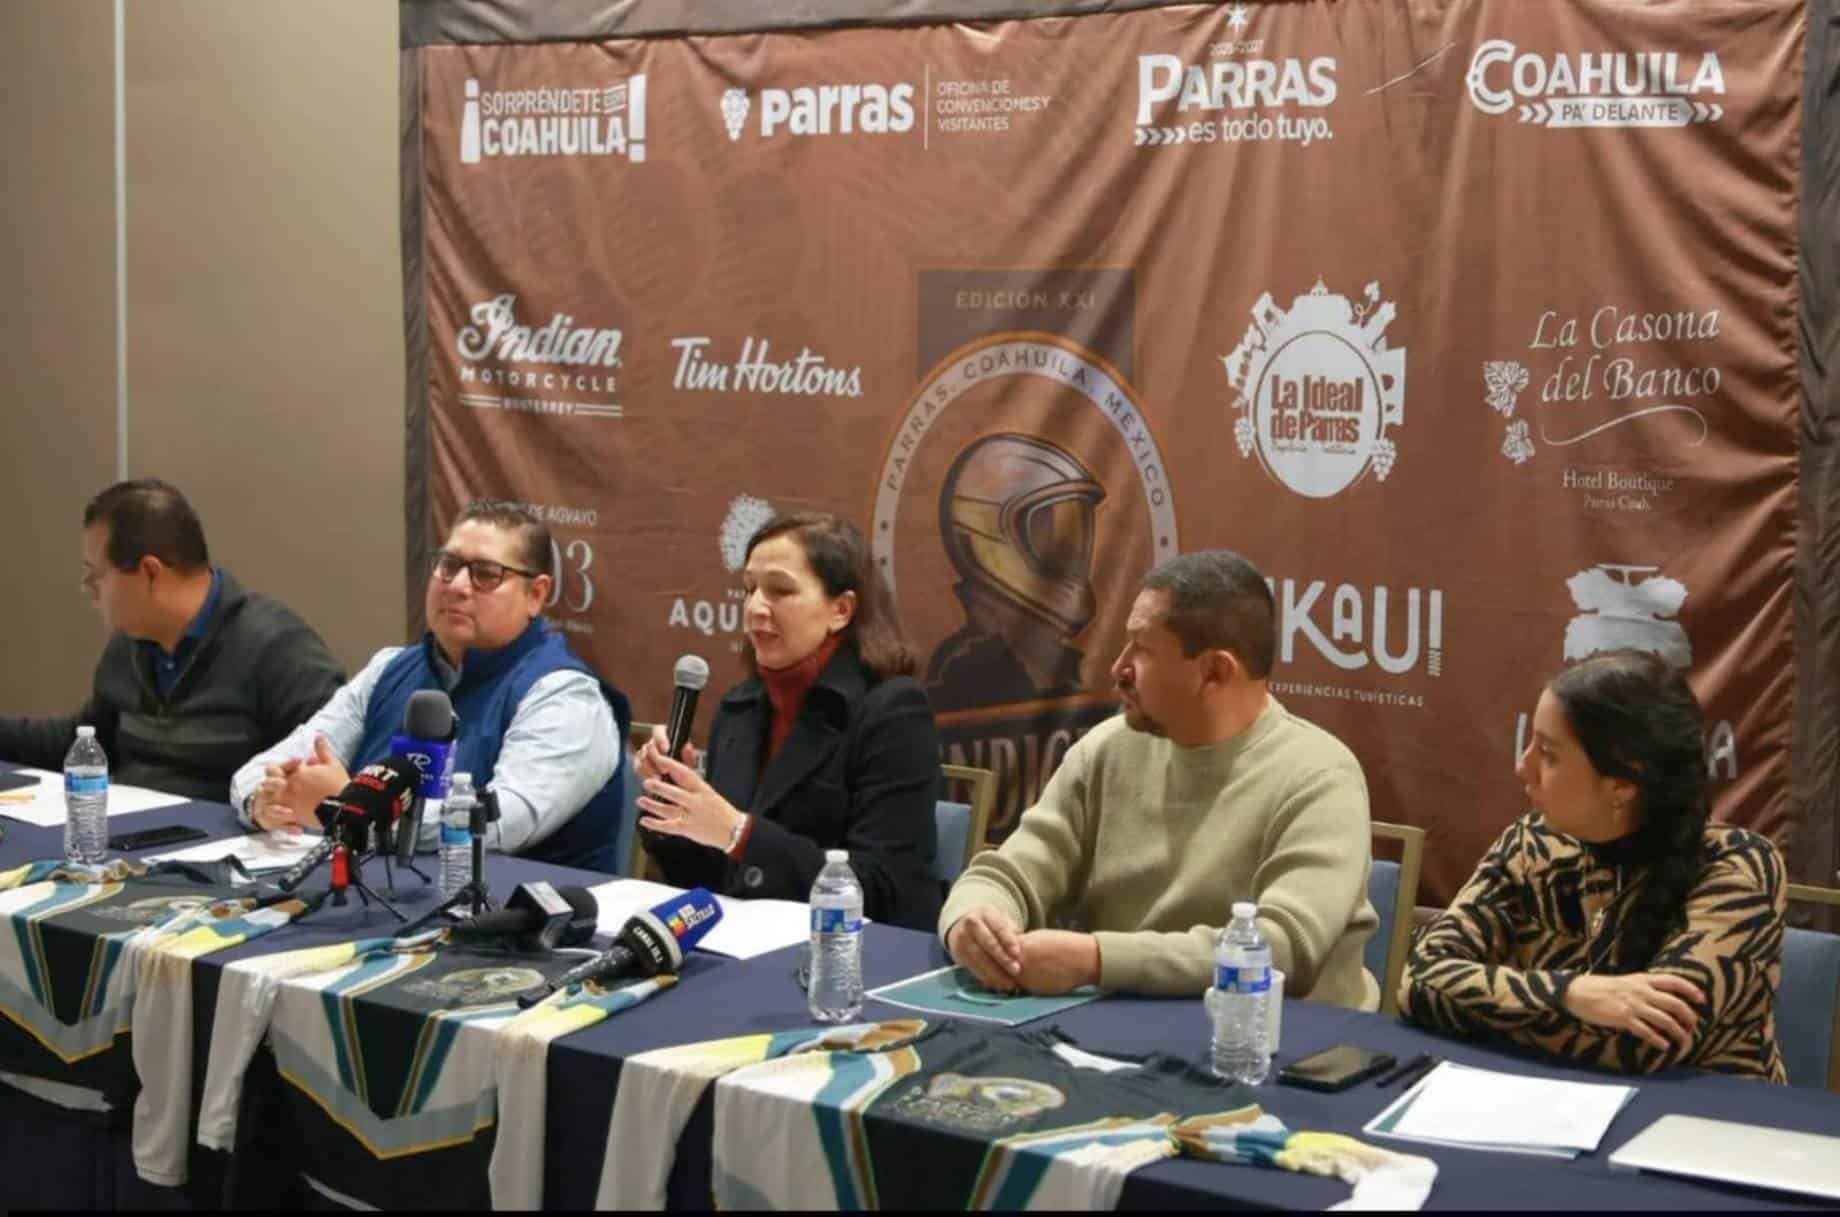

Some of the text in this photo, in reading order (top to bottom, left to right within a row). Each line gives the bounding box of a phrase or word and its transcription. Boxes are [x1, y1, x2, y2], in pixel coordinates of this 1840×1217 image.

[1136, 53, 1338, 126] PARRAS
[1466, 39, 1726, 114] COAHUILA
[936, 115, 1009, 131] VISITANTES
[1188, 121, 1216, 142] es
[1222, 113, 1273, 142] todo
[1593, 103, 1680, 121] DELANTE
[457, 293, 622, 367] Indian
[1528, 306, 1721, 349] La Casona
[461, 366, 617, 393] MOTORCYCLE
[671, 336, 862, 397] Tim Hortons
[1542, 354, 1722, 403] del Banco
[1271, 374, 1363, 412] La Ideal
[1270, 409, 1297, 440] de
[1562, 470, 1674, 496] Hotel Boutique
[668, 597, 739, 636] AQU
